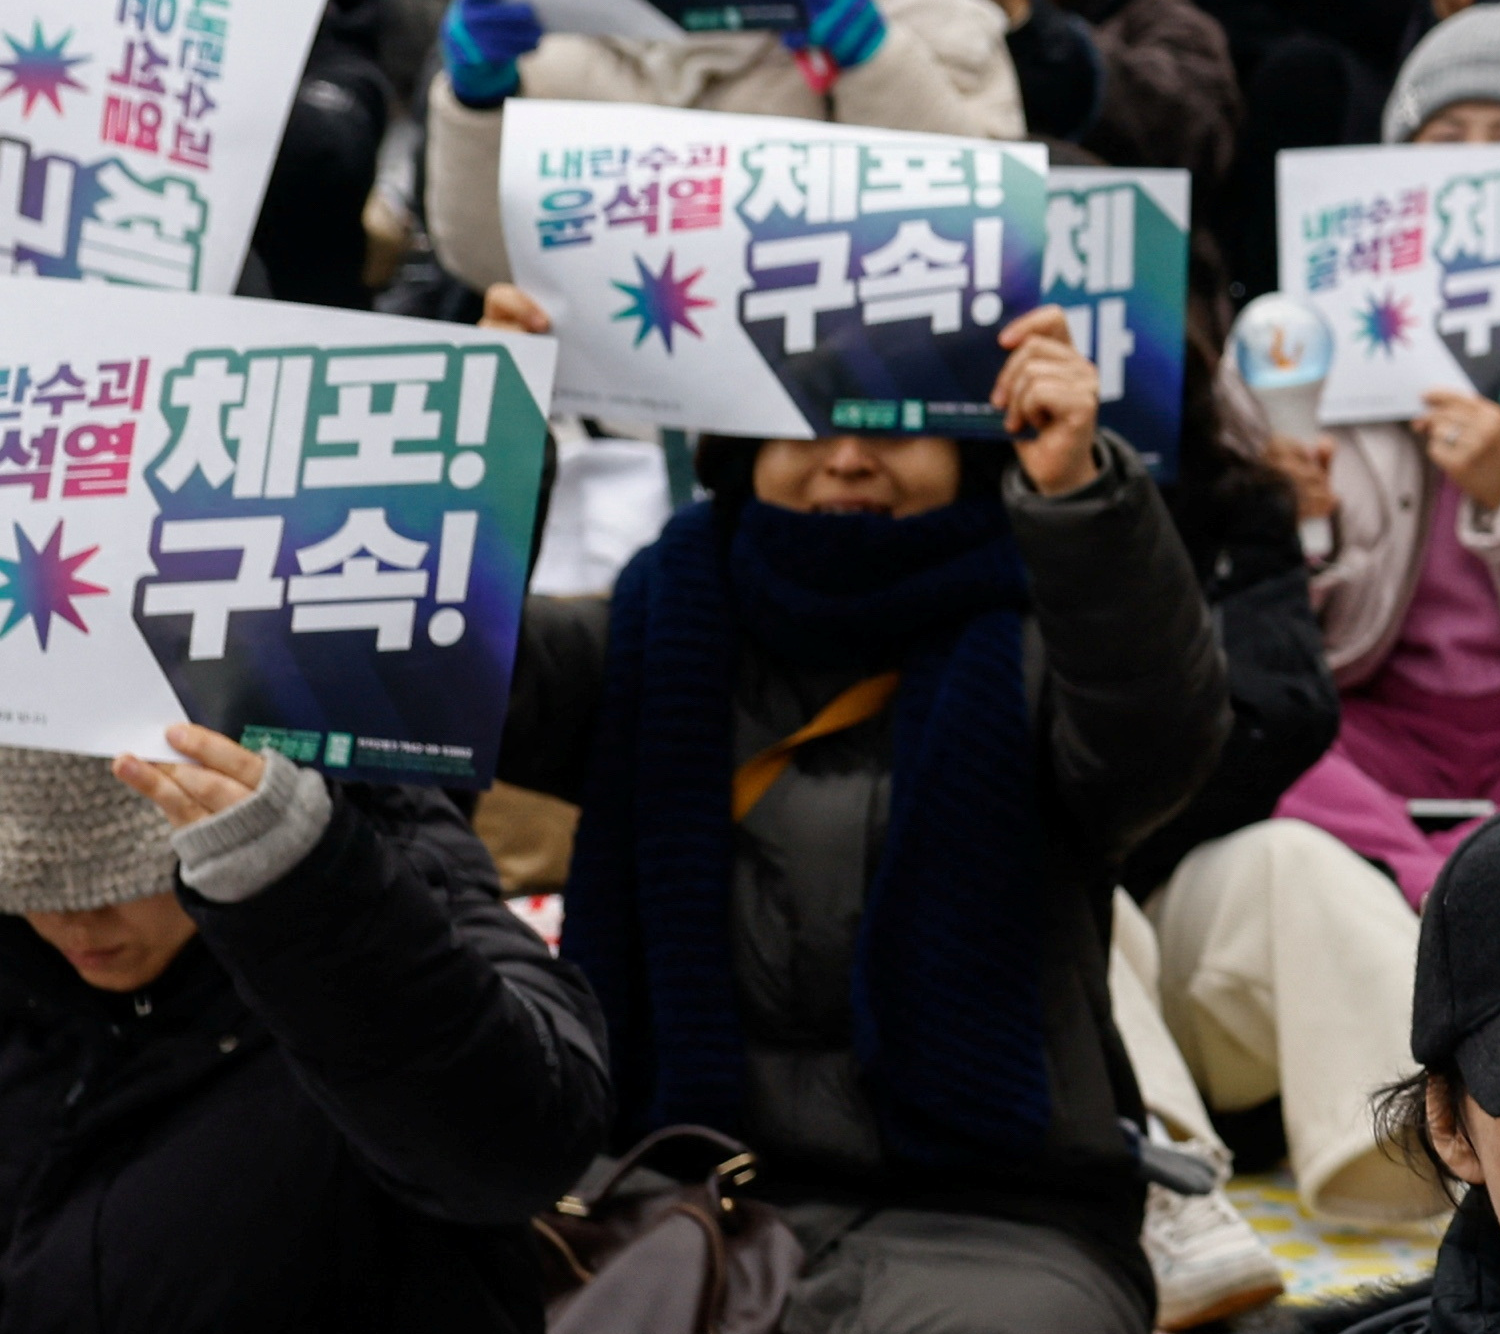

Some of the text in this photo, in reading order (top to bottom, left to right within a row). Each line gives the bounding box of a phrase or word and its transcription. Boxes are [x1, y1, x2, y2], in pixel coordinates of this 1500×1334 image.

[537, 144, 728, 182] 내란수괴
[741, 141, 1004, 224] 체포!
[535, 175, 725, 252] 윤석열
[743, 216, 1004, 356] 구속!
[1304, 228, 1425, 293] 윤석열
[150, 346, 502, 501] 체포!
[142, 506, 480, 661] 구속!
